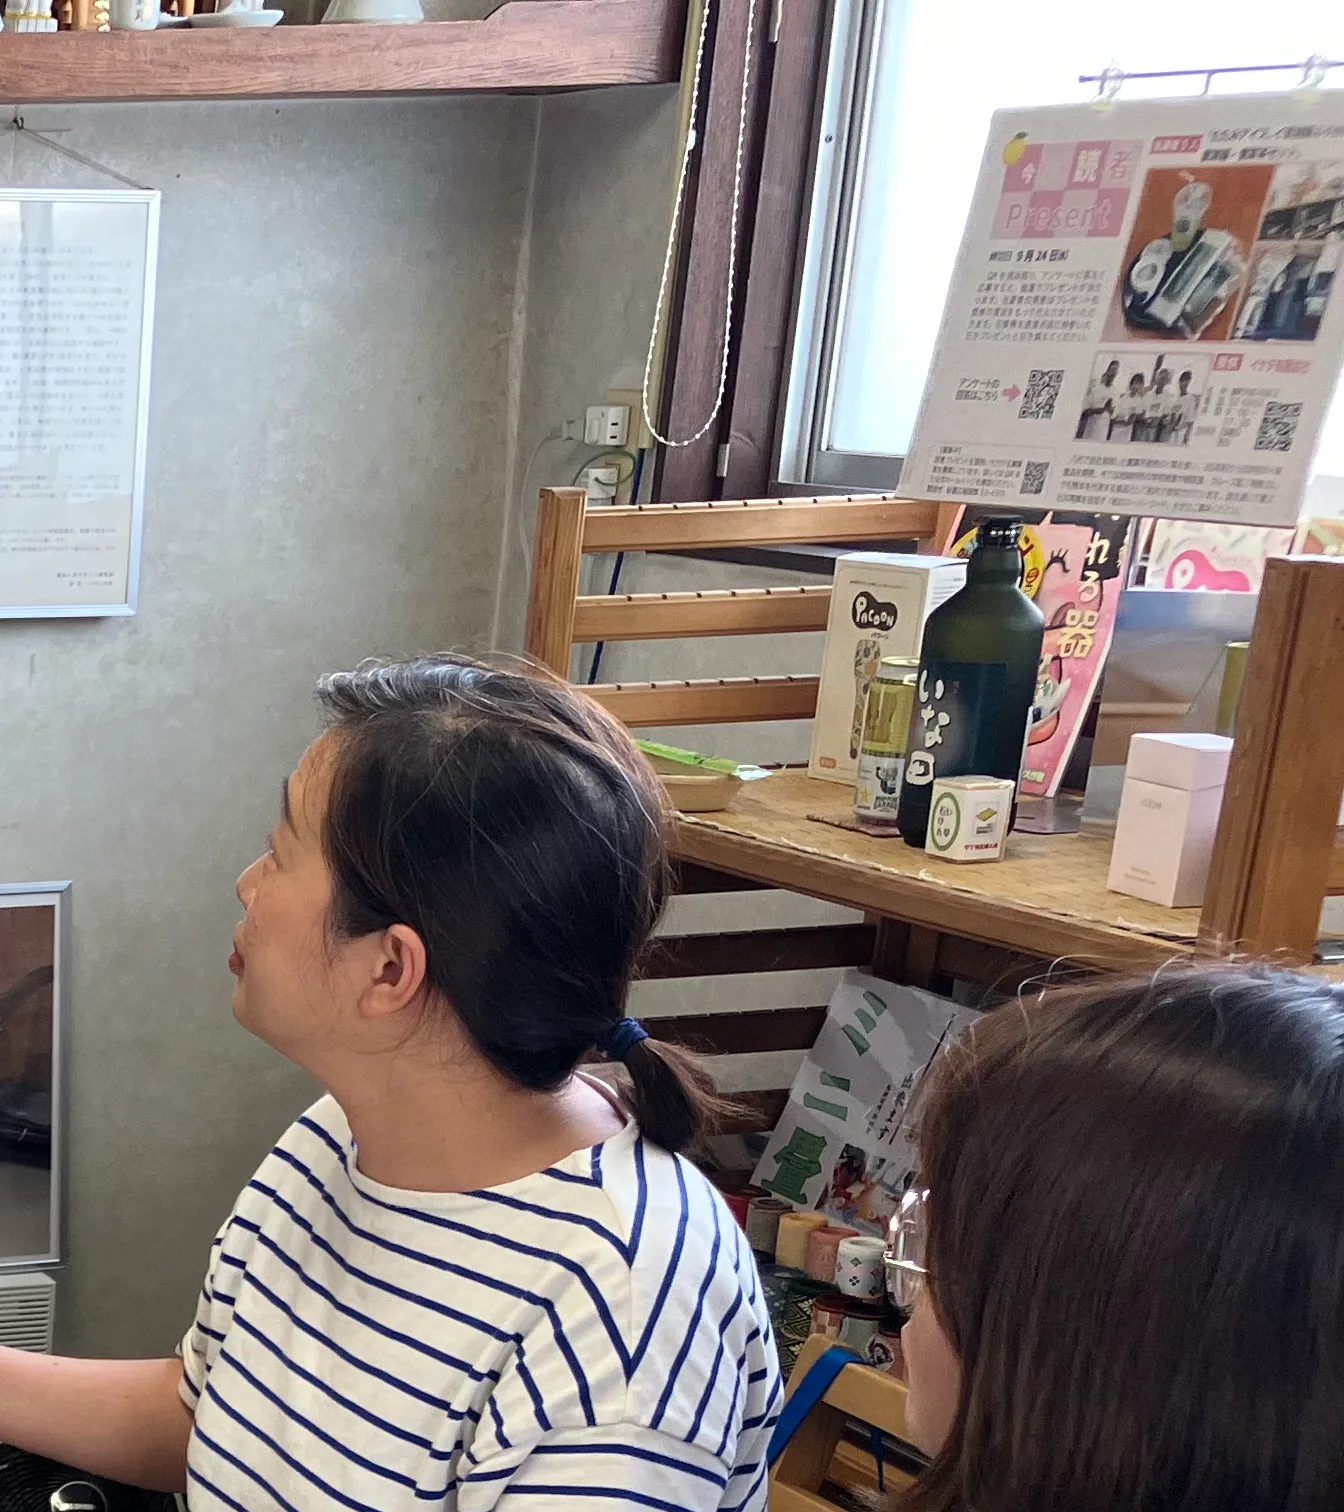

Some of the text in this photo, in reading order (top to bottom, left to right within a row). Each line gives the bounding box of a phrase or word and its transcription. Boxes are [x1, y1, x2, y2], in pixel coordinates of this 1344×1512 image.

[1005, 198, 1112, 232] Present
[1056, 514, 1120, 658] れる器
